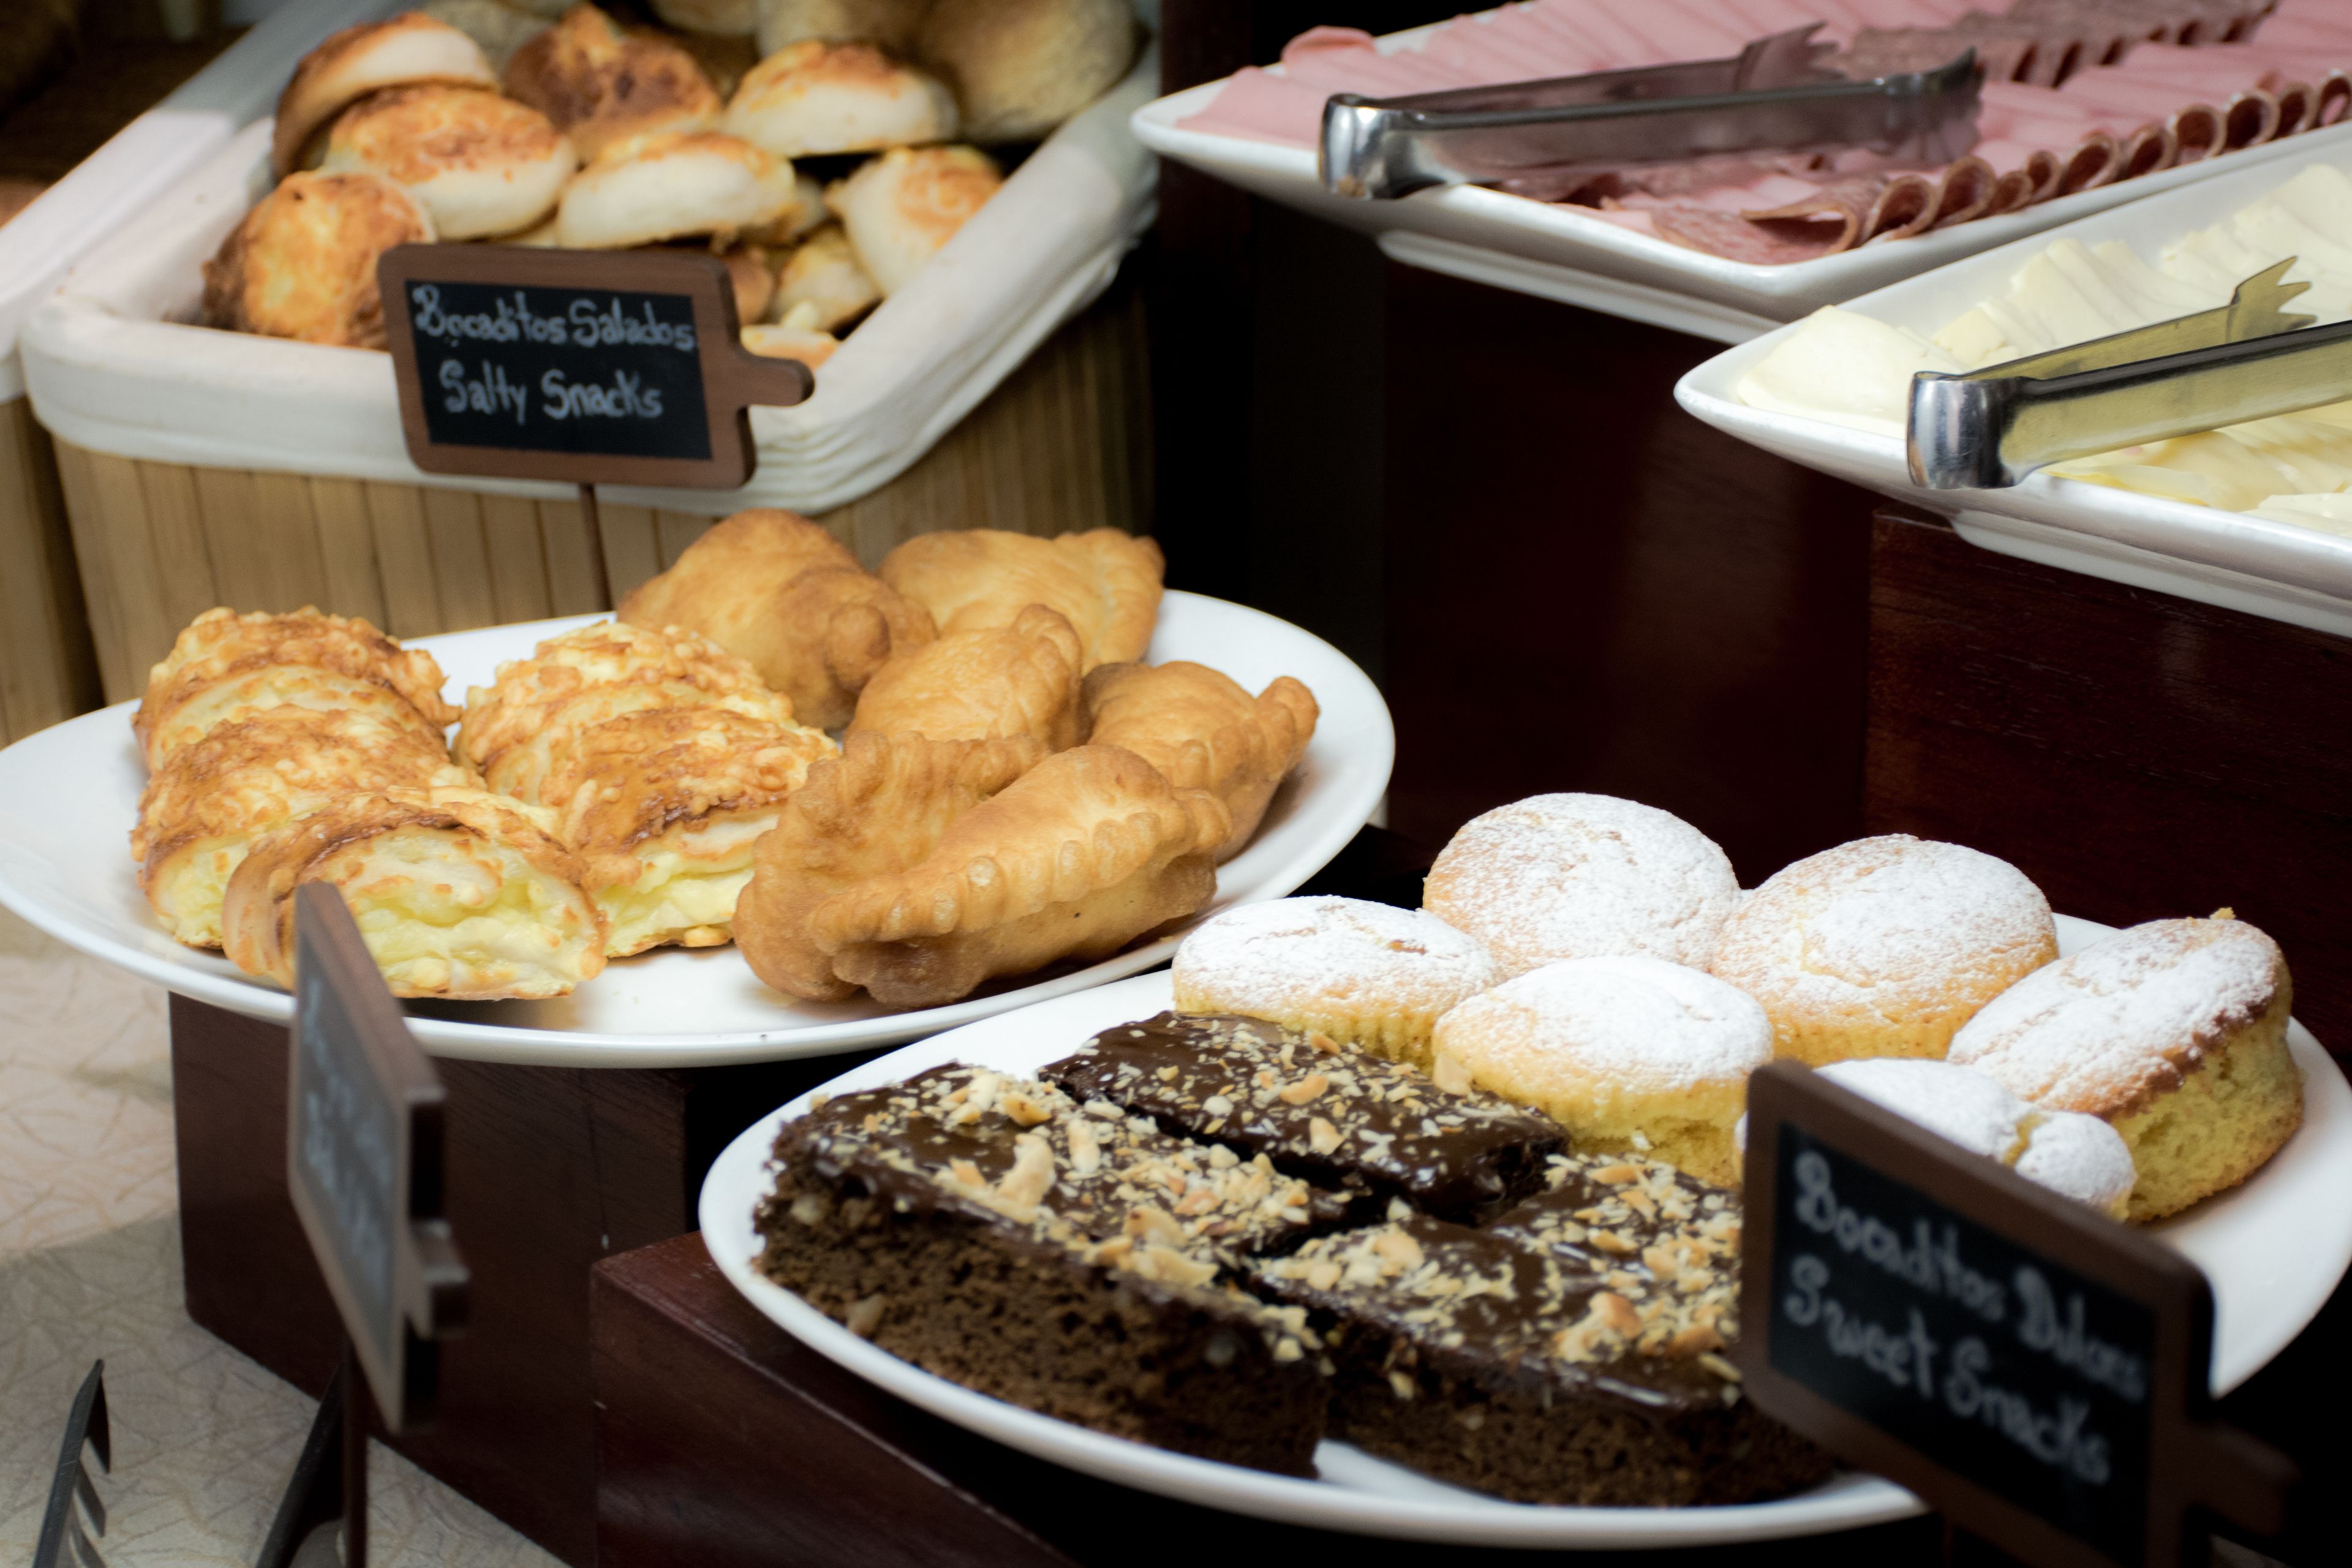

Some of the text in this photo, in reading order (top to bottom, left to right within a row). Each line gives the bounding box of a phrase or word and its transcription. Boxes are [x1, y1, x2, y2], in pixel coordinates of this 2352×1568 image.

[412, 284, 696, 352] Bocaditos Salados
[439, 359, 663, 426] Salty Snacks
[1784, 1254, 2111, 1486] Sweet Snacks
